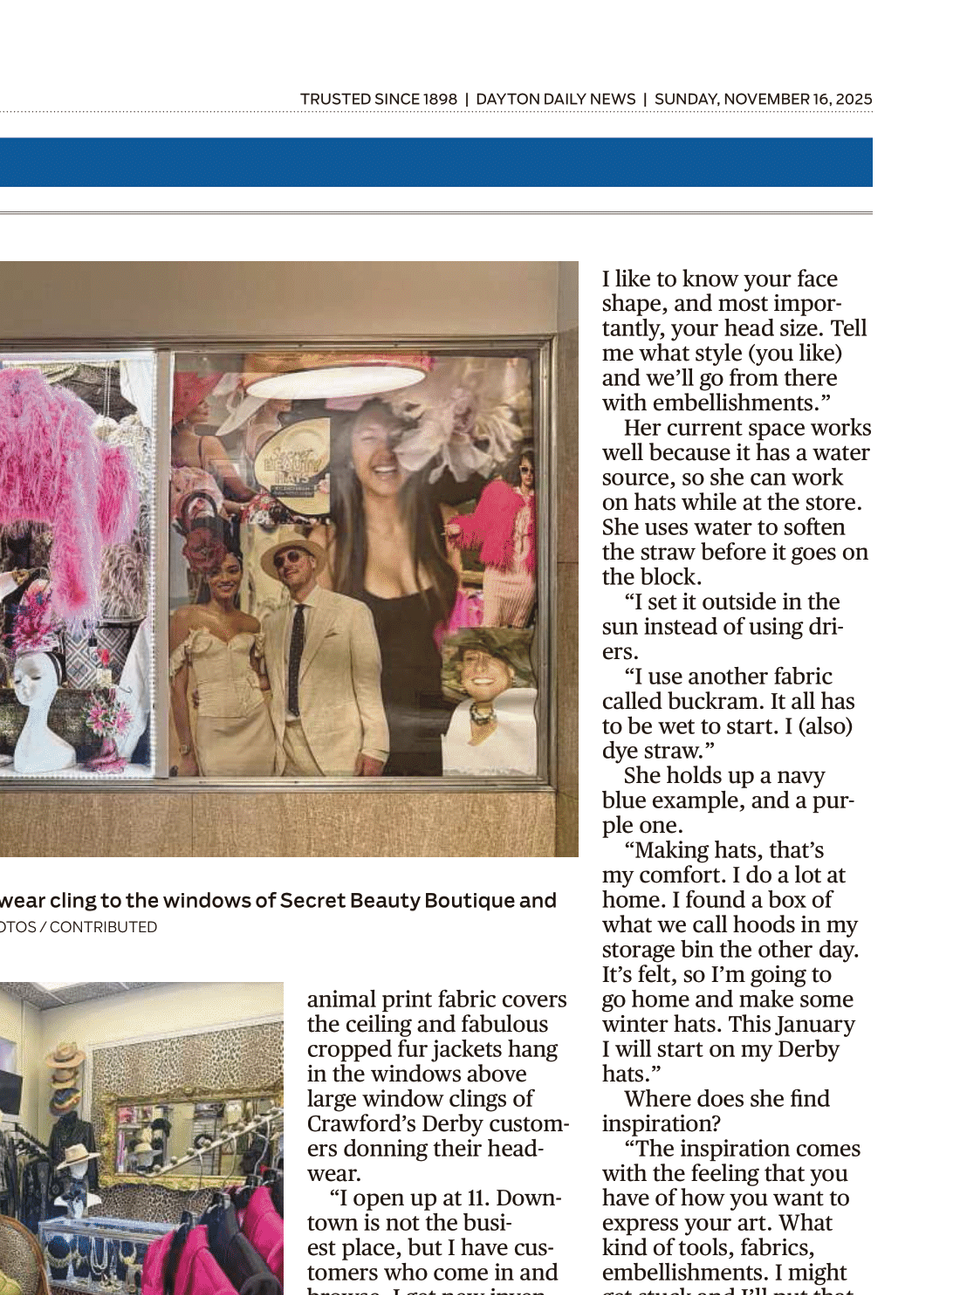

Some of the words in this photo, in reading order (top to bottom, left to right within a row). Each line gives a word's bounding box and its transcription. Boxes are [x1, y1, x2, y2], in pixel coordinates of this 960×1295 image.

[300, 93, 371, 105] TRUSTED
[375, 93, 419, 105] SINCE
[424, 93, 457, 105] 1898
[477, 93, 539, 105] DAYTON
[544, 93, 586, 105] DAILY
[591, 93, 635, 105] NEWS
[655, 93, 720, 106] SUNDAY,
[725, 93, 809, 106] NOVEMBER
[814, 94, 832, 106] 16,
[836, 94, 872, 105] 2025
[51, 892, 97, 911] cling
[101, 893, 121, 908] to
[126, 892, 158, 908] the
[163, 892, 251, 908] windows
[256, 892, 277, 908] of
[281, 893, 346, 908] Secret
[351, 893, 421, 911] Beauty
[426, 893, 515, 911] Boutique
[520, 892, 556, 908] and
[50, 921, 157, 933] CONTRIBUTED
